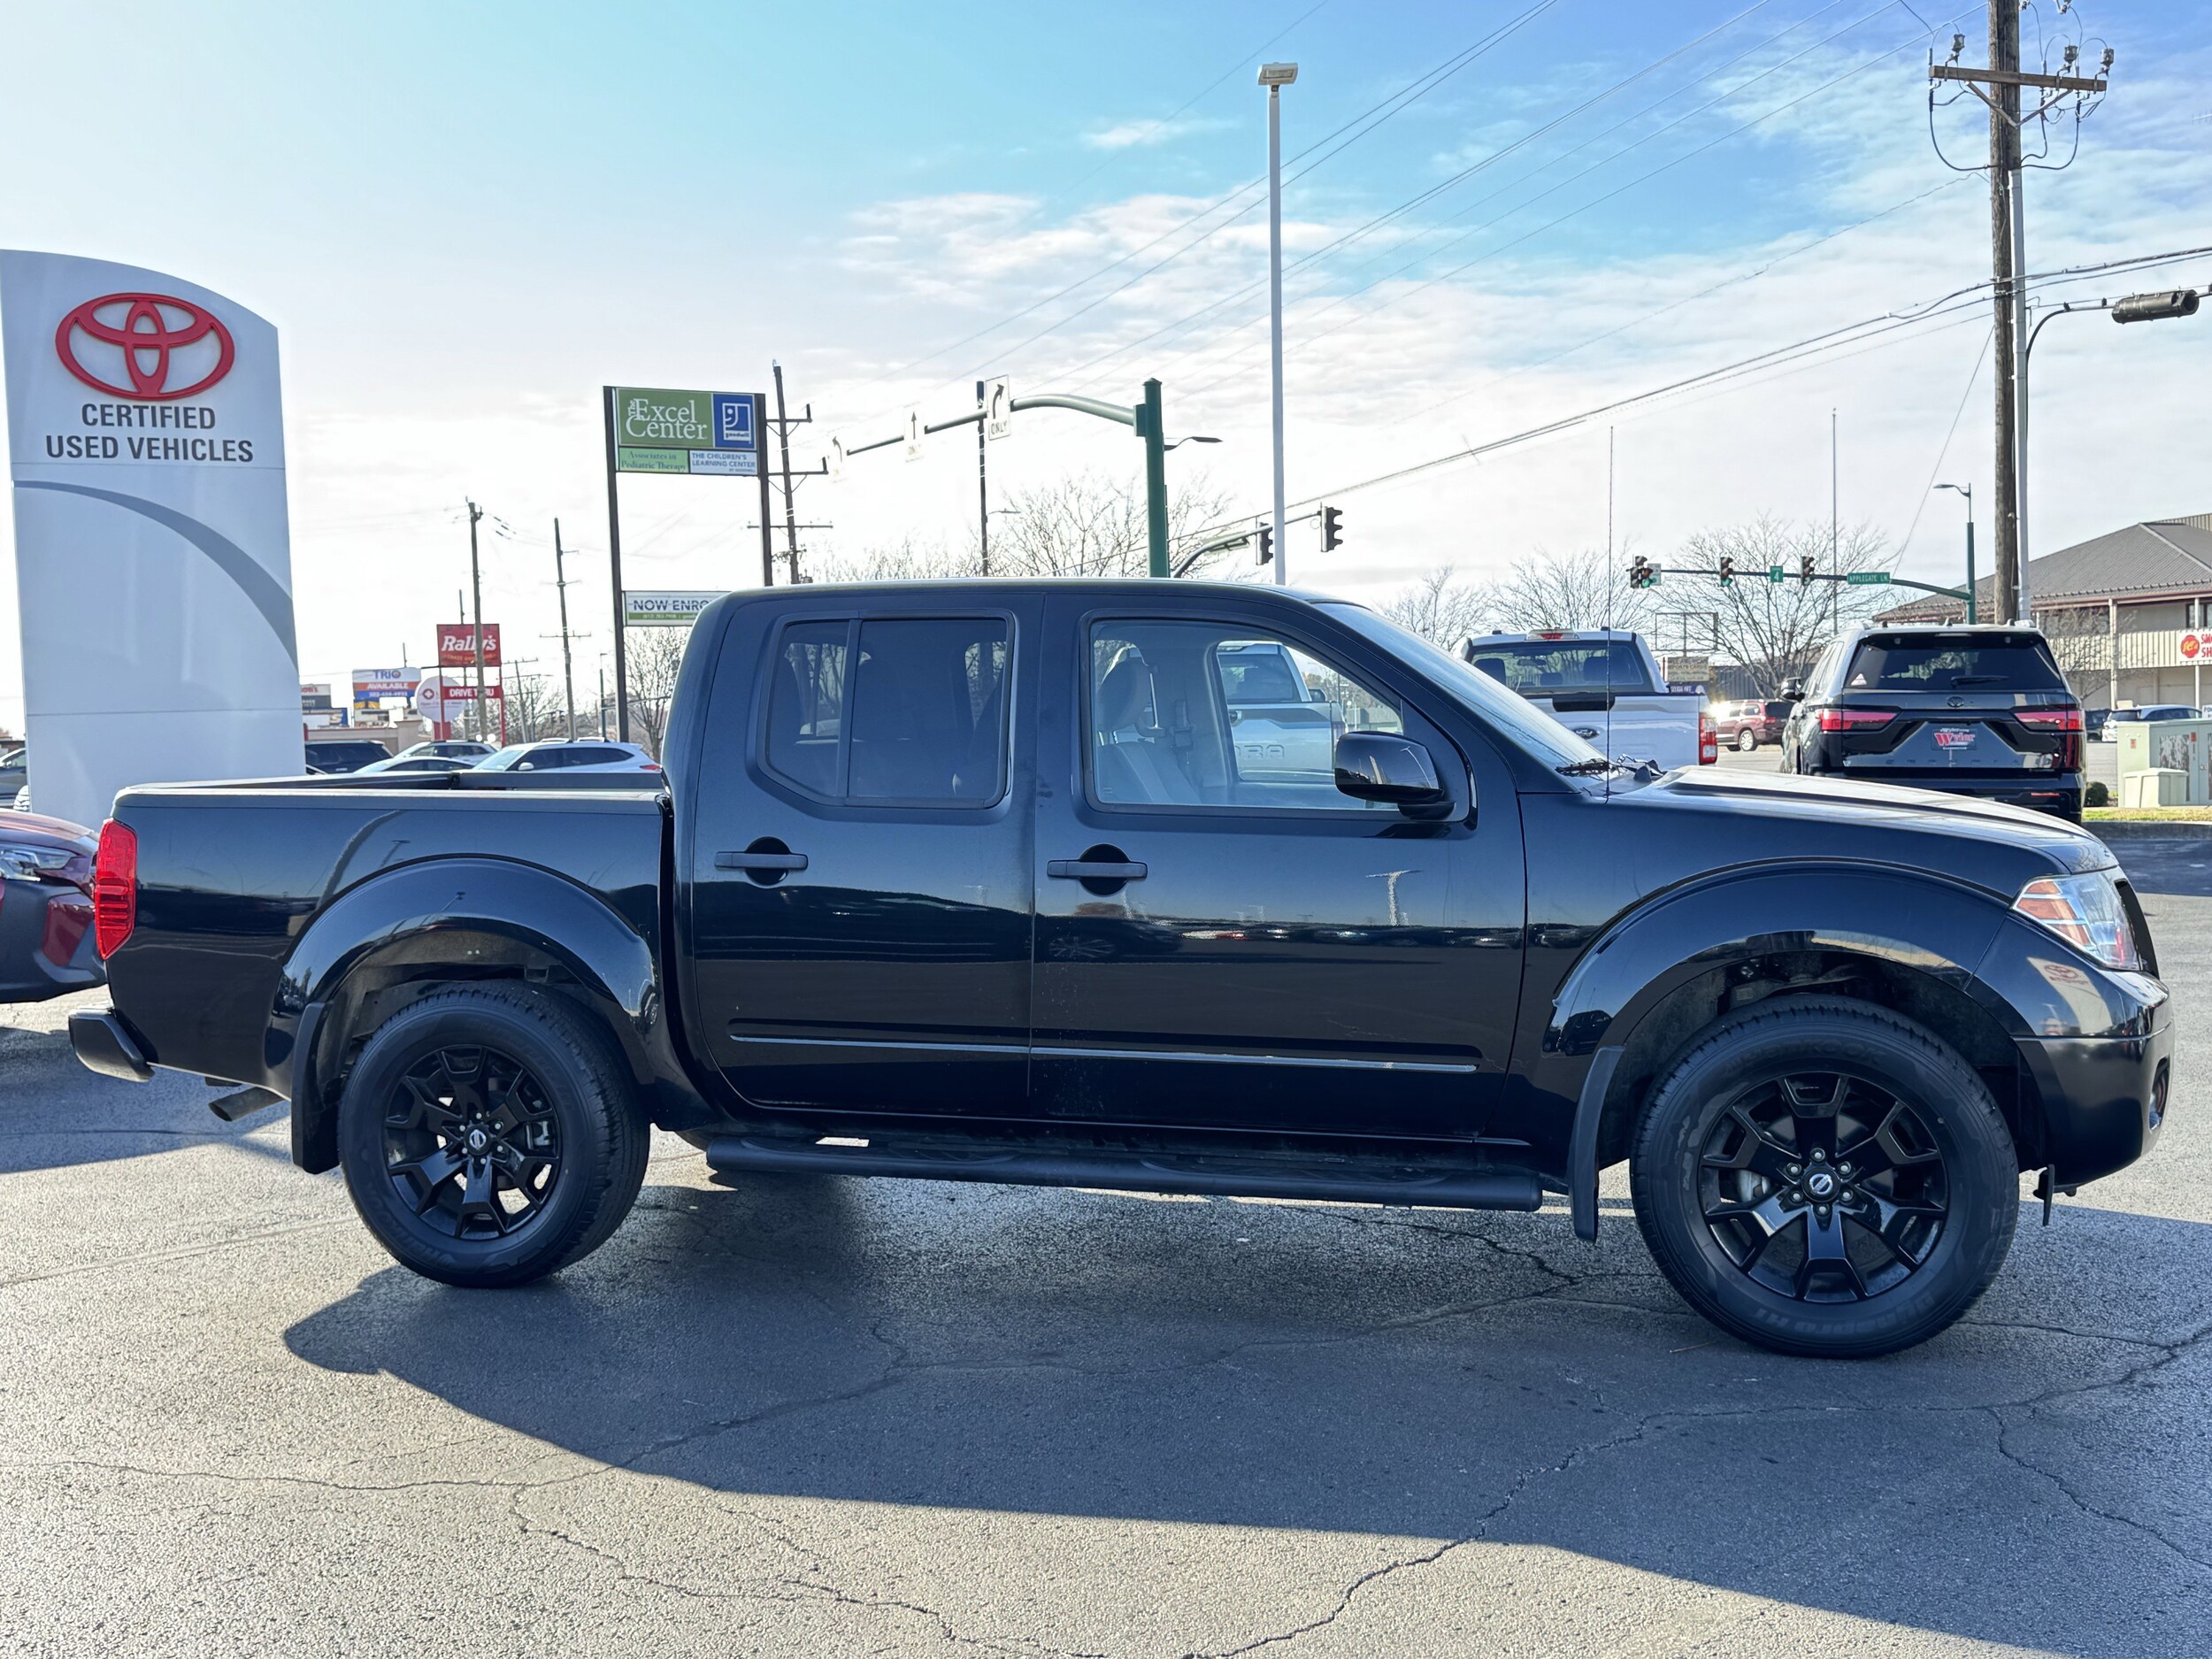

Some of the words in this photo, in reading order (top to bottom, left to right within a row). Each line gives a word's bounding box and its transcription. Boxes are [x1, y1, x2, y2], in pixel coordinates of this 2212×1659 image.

[627, 399, 636, 417] The
[633, 398, 697, 424] Excel
[81, 403, 216, 430] CERTIFIED
[626, 414, 708, 440] Center
[46, 435, 119, 459] USED
[127, 436, 254, 463] VEHICLES
[628, 450, 667, 459] Associates
[669, 451, 677, 460] in
[621, 460, 656, 469] Pediatric
[656, 461, 687, 472] Therapy
[1773, 571, 1779, 581] 4
[634, 600, 669, 611] NOW
[374, 670, 402, 680] TRIO
[449, 688, 473, 697] DRIVE
[473, 687, 495, 696] TRU
